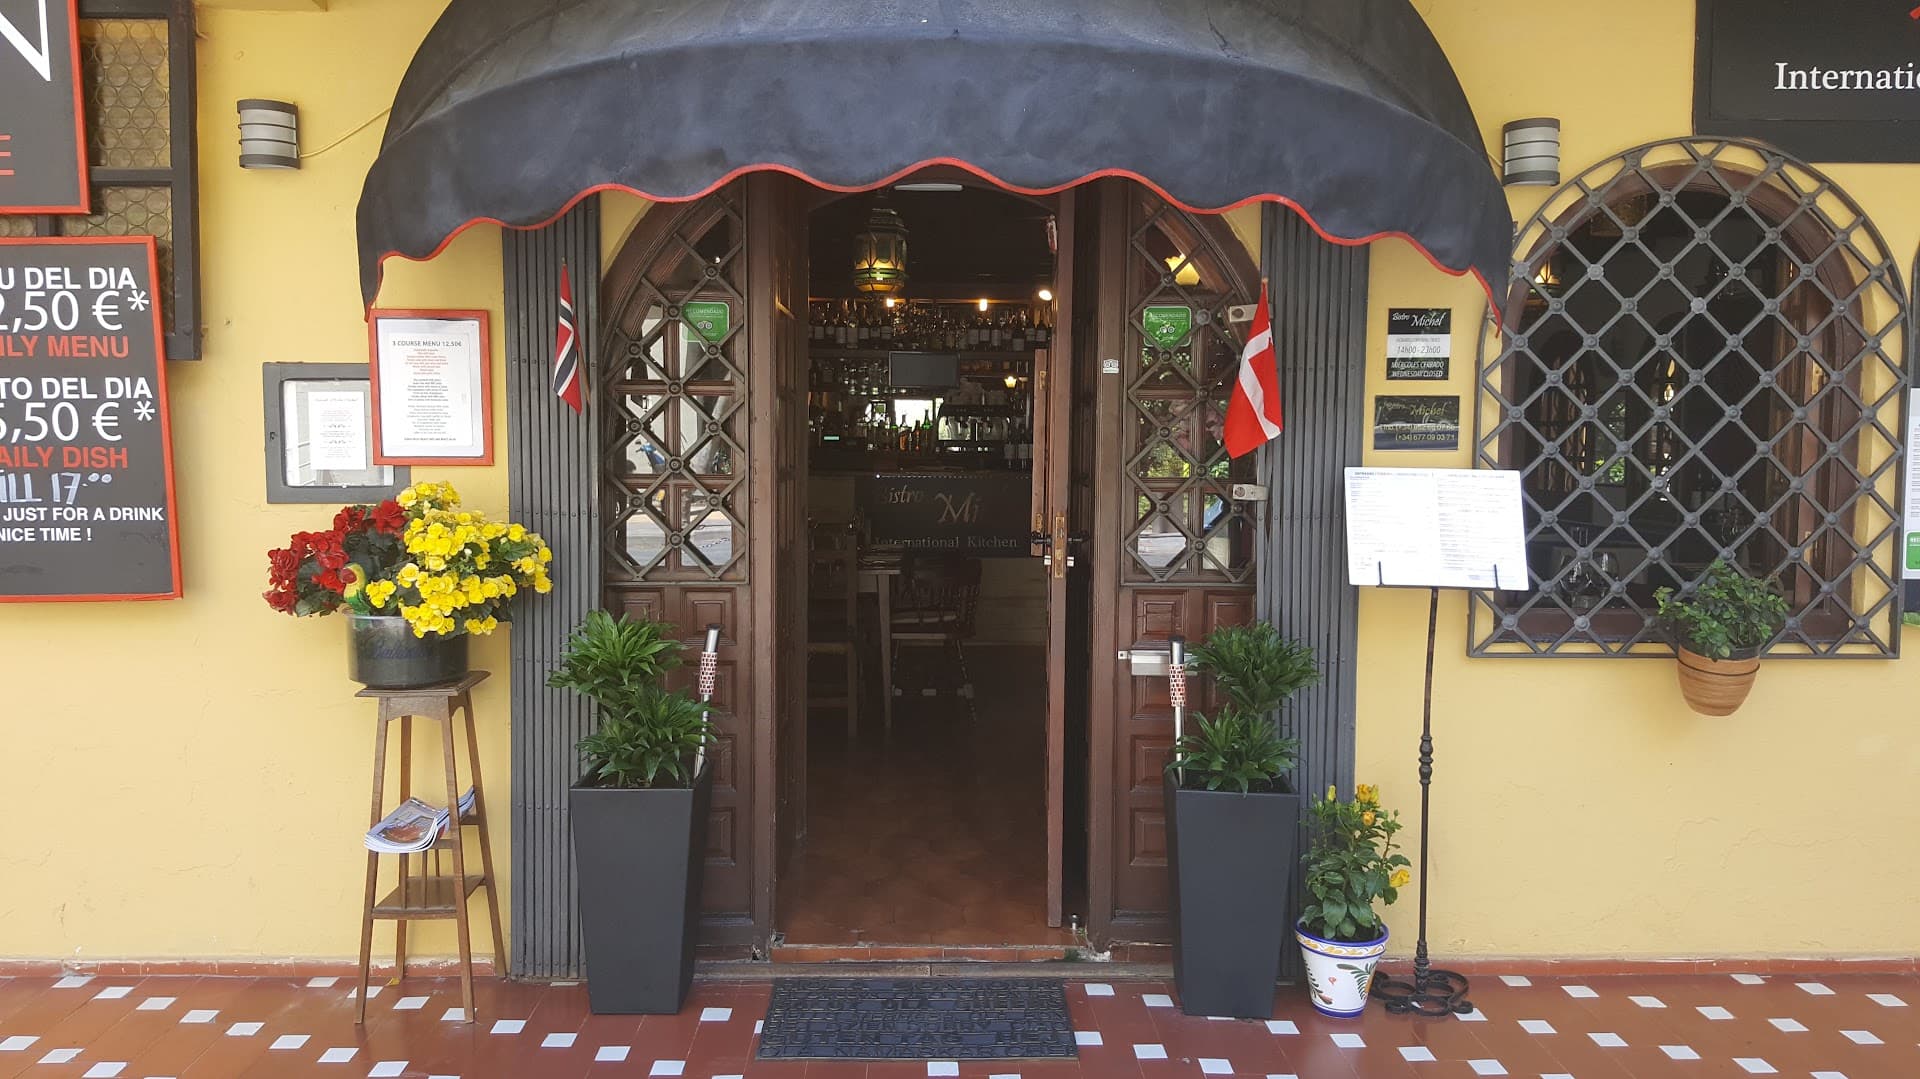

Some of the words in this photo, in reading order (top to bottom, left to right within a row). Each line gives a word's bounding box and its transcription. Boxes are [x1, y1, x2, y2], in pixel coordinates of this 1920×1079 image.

[1774, 62, 1920, 90] Internati
[24, 268, 81, 290] DEL
[88, 268, 138, 289] DIA
[1411, 312, 1446, 327] Michel
[47, 335, 129, 358] MENU
[41, 377, 97, 399] DEL
[104, 377, 153, 399] DIA
[63, 447, 128, 469] DISH
[0, 469, 42, 503] ILL
[3, 507, 47, 521] JUST
[53, 508, 88, 521] FOR
[93, 508, 105, 521] A
[110, 508, 164, 521] DRINK
[40, 528, 81, 541] TIME
[967, 535, 1018, 549] Kitchen
